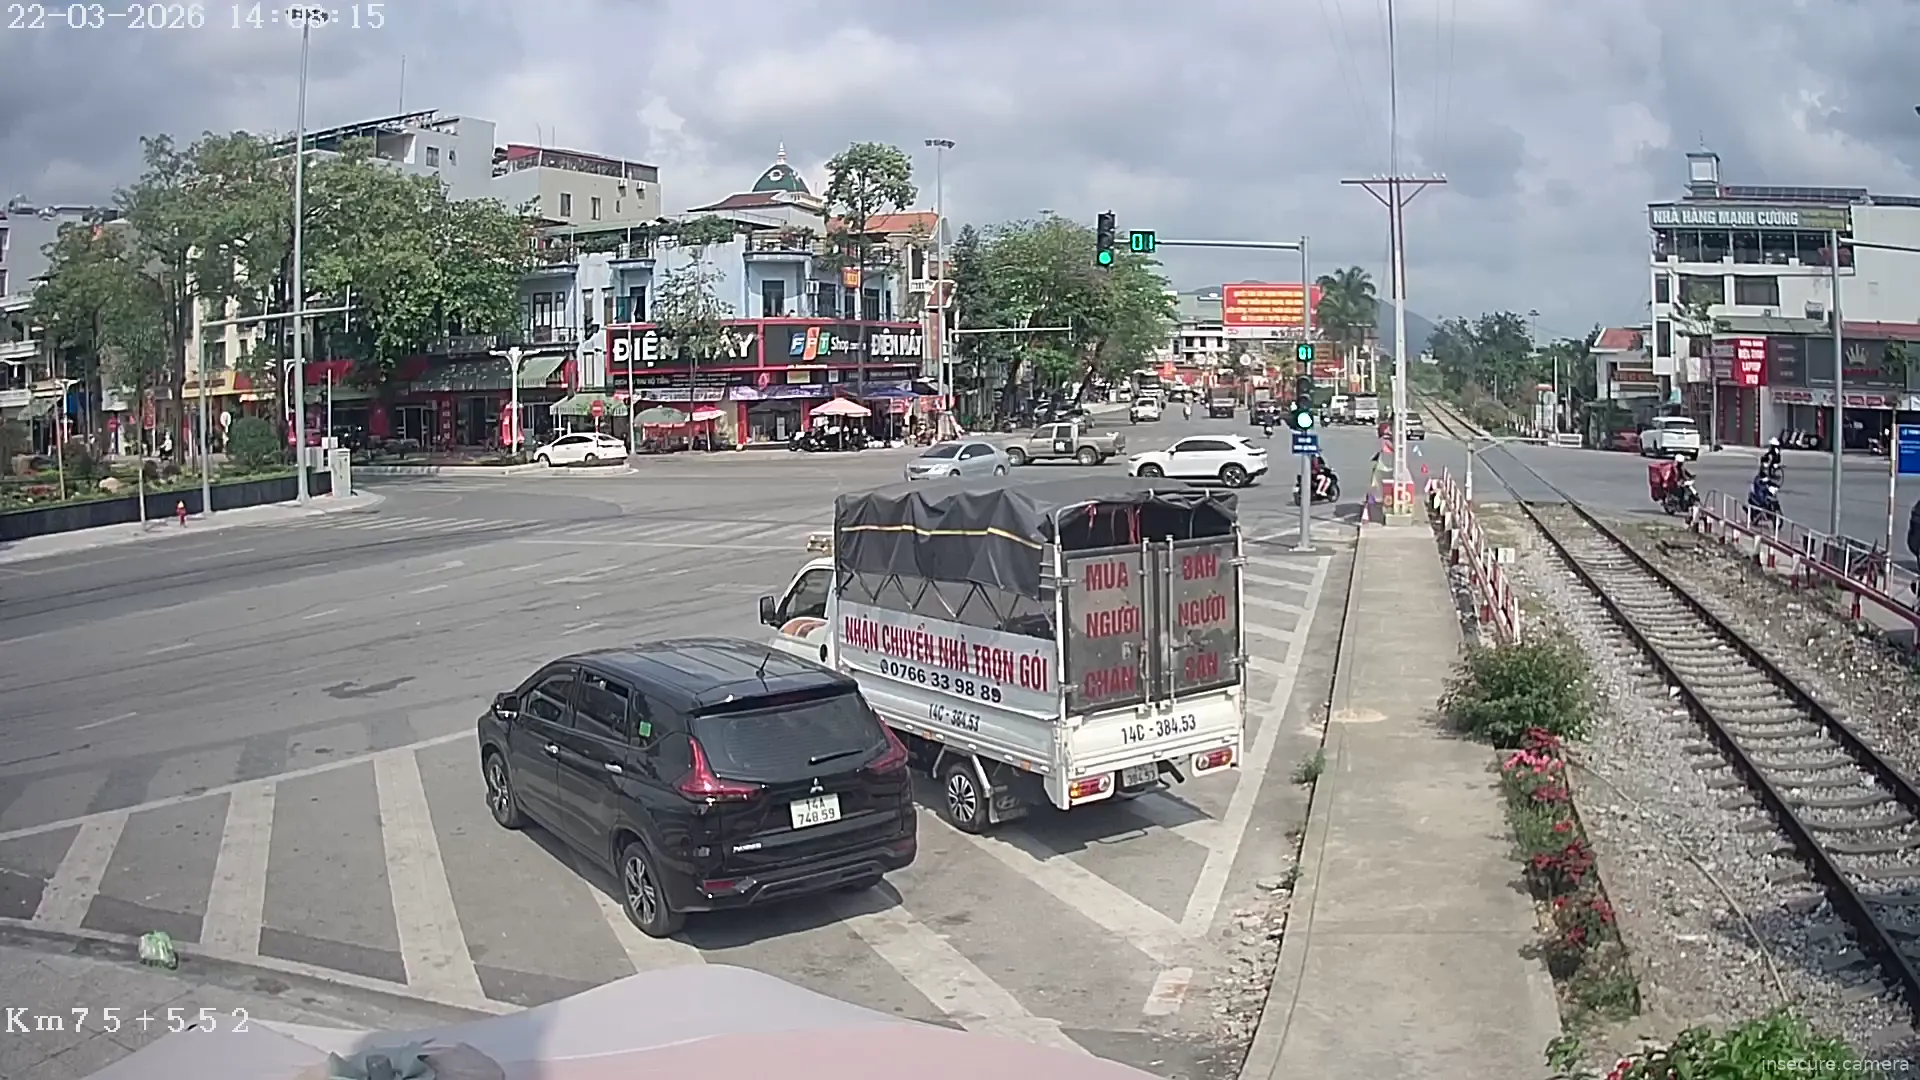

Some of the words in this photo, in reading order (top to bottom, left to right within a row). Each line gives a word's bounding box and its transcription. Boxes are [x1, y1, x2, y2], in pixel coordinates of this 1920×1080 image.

[1653, 207, 1680, 225] NHÀ
[1682, 207, 1716, 225] HÀNG
[1718, 211, 1756, 228] MẠNH
[1758, 208, 1799, 225] CƯỜNG
[1132, 233, 1154, 250] 01
[871, 328, 898, 361] ĐIỆN
[1298, 347, 1312, 360] 01
[845, 614, 878, 654] NHẬN
[882, 623, 934, 666] CHUYỂN
[938, 634, 969, 673] NHÀ
[973, 643, 1014, 687] TRỌN
[1019, 649, 1048, 692] GÓI
[890, 662, 926, 684] 0766
[931, 672, 950, 690] 33
[954, 678, 976, 696] 98
[980, 685, 1002, 703] 89
[928, 703, 944, 721] 14C
[950, 709, 981, 731] 384.53
[1121, 724, 1145, 744] 14C
[1156, 714, 1196, 737] 384.53
[806, 797, 826, 810] 14A
[798, 808, 835, 825] 748.59
